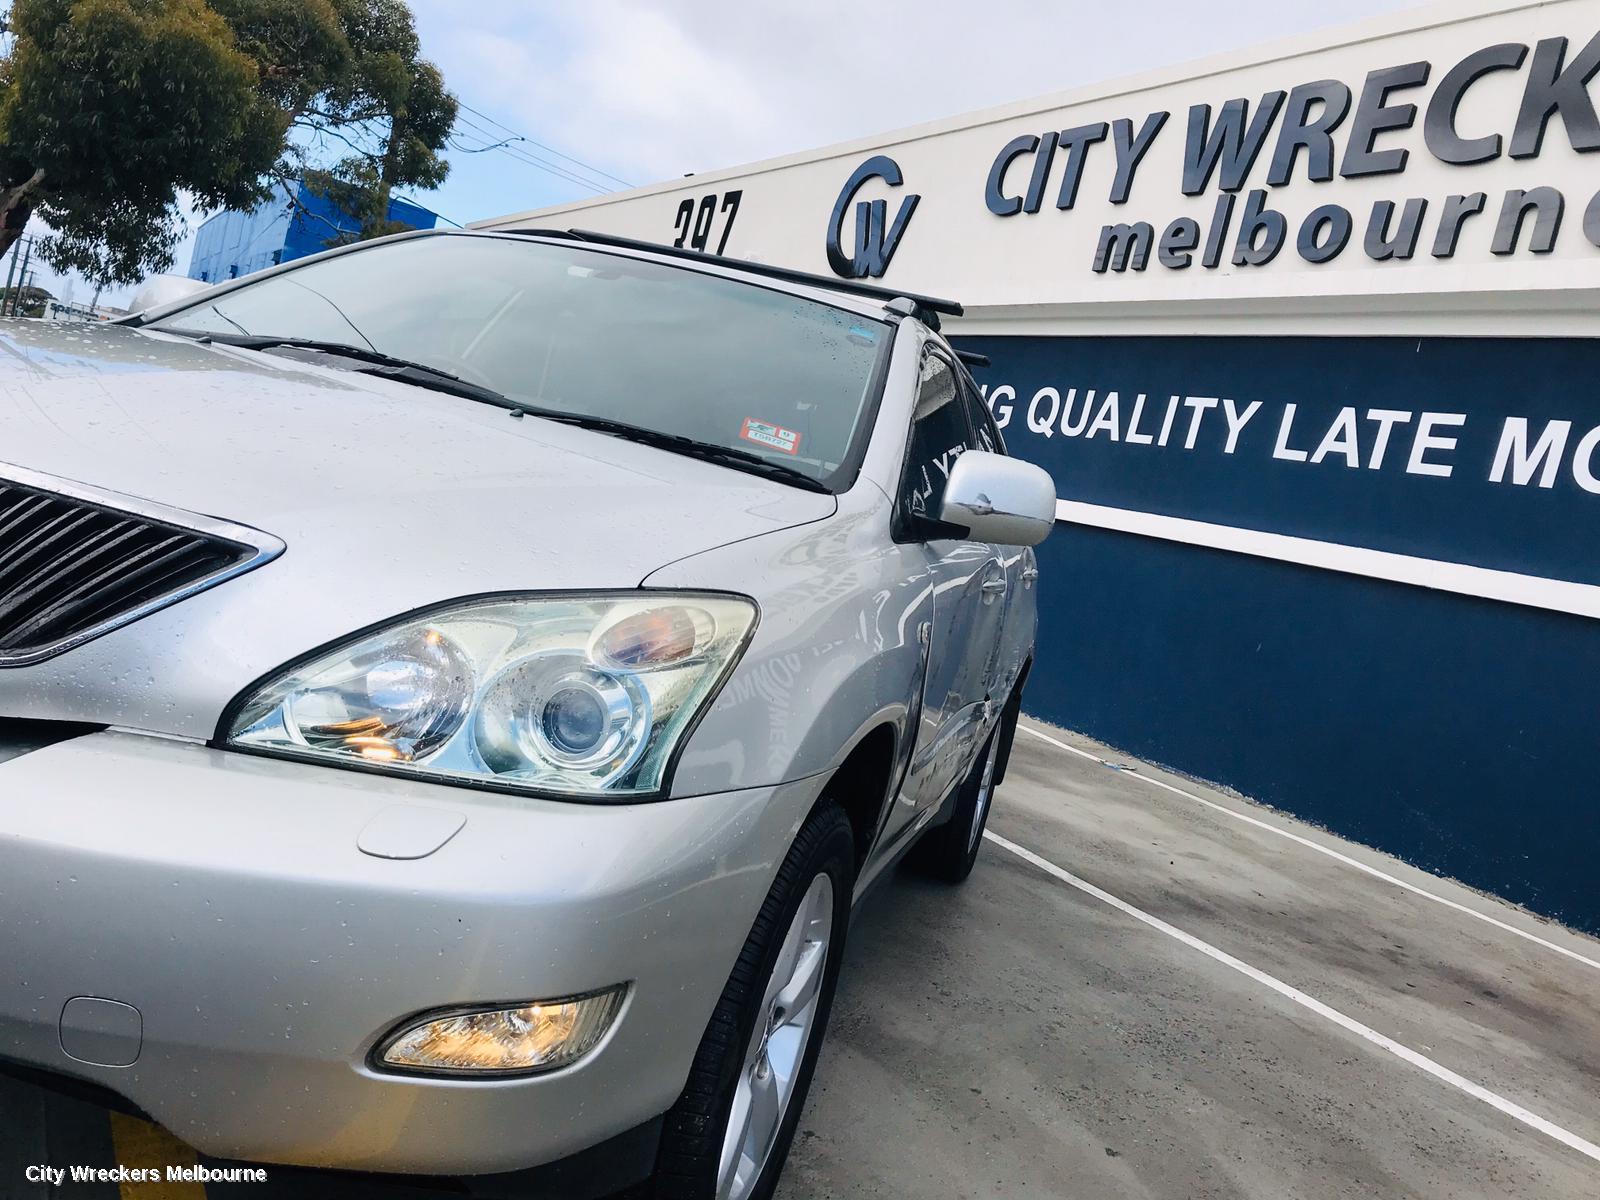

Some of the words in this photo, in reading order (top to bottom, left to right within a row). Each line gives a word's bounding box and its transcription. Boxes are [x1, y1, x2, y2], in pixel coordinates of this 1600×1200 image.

[984, 111, 1170, 218] CITY
[1180, 30, 1600, 197] WRECK
[673, 190, 743, 256] 397
[1026, 386, 1264, 454] QUALITY
[1272, 403, 1467, 478] LATE
